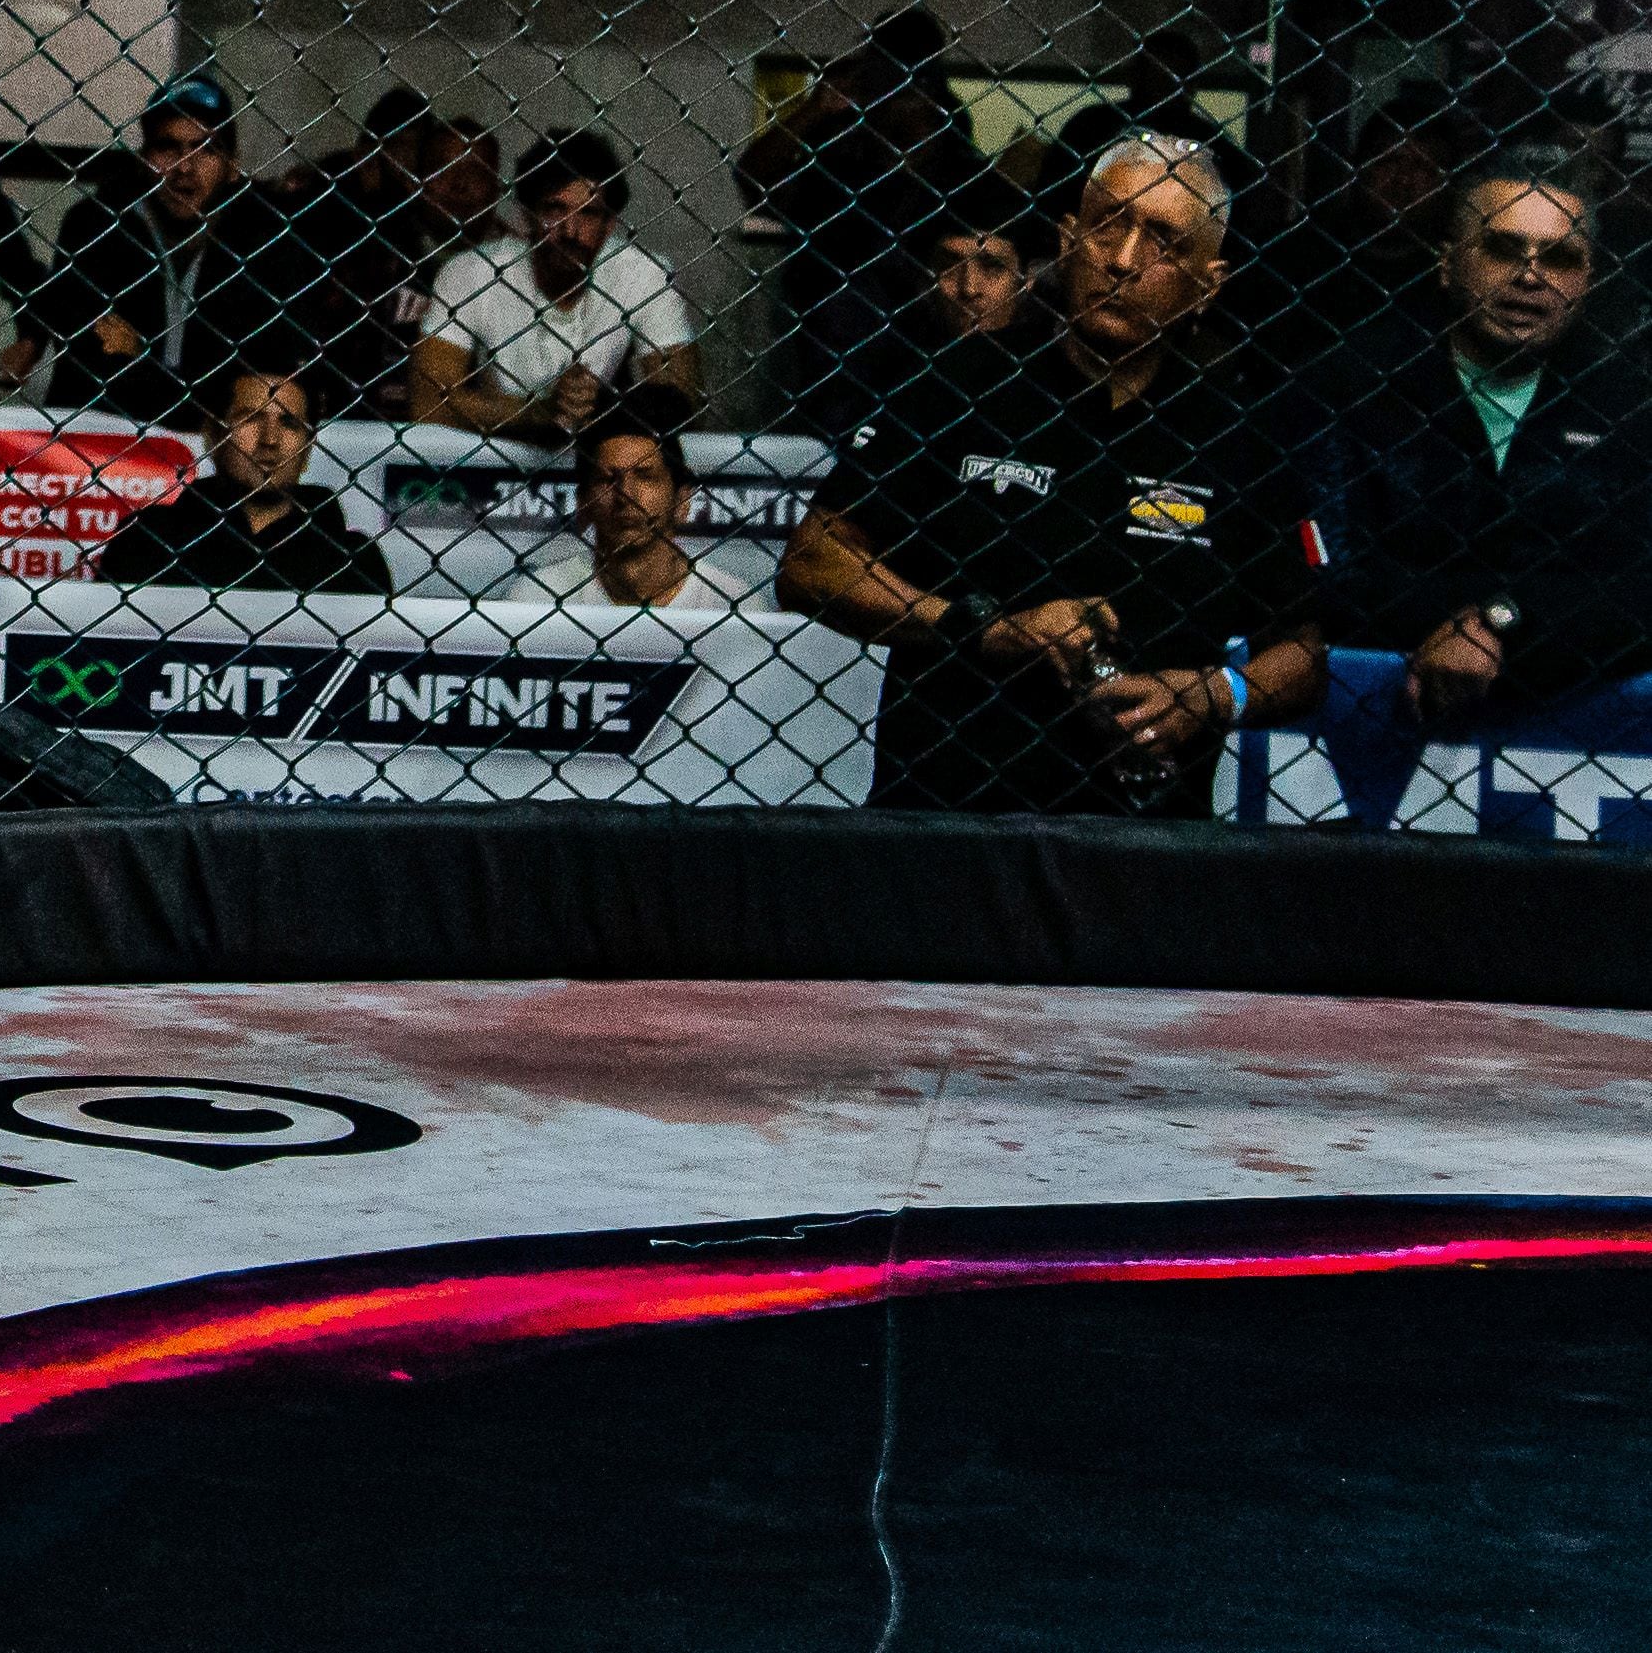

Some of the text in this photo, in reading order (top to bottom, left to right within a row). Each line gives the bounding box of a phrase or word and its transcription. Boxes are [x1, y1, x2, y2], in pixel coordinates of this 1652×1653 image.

[0, 505, 119, 533] CON TU
[149, 662, 631, 732] JMT INFINITE
